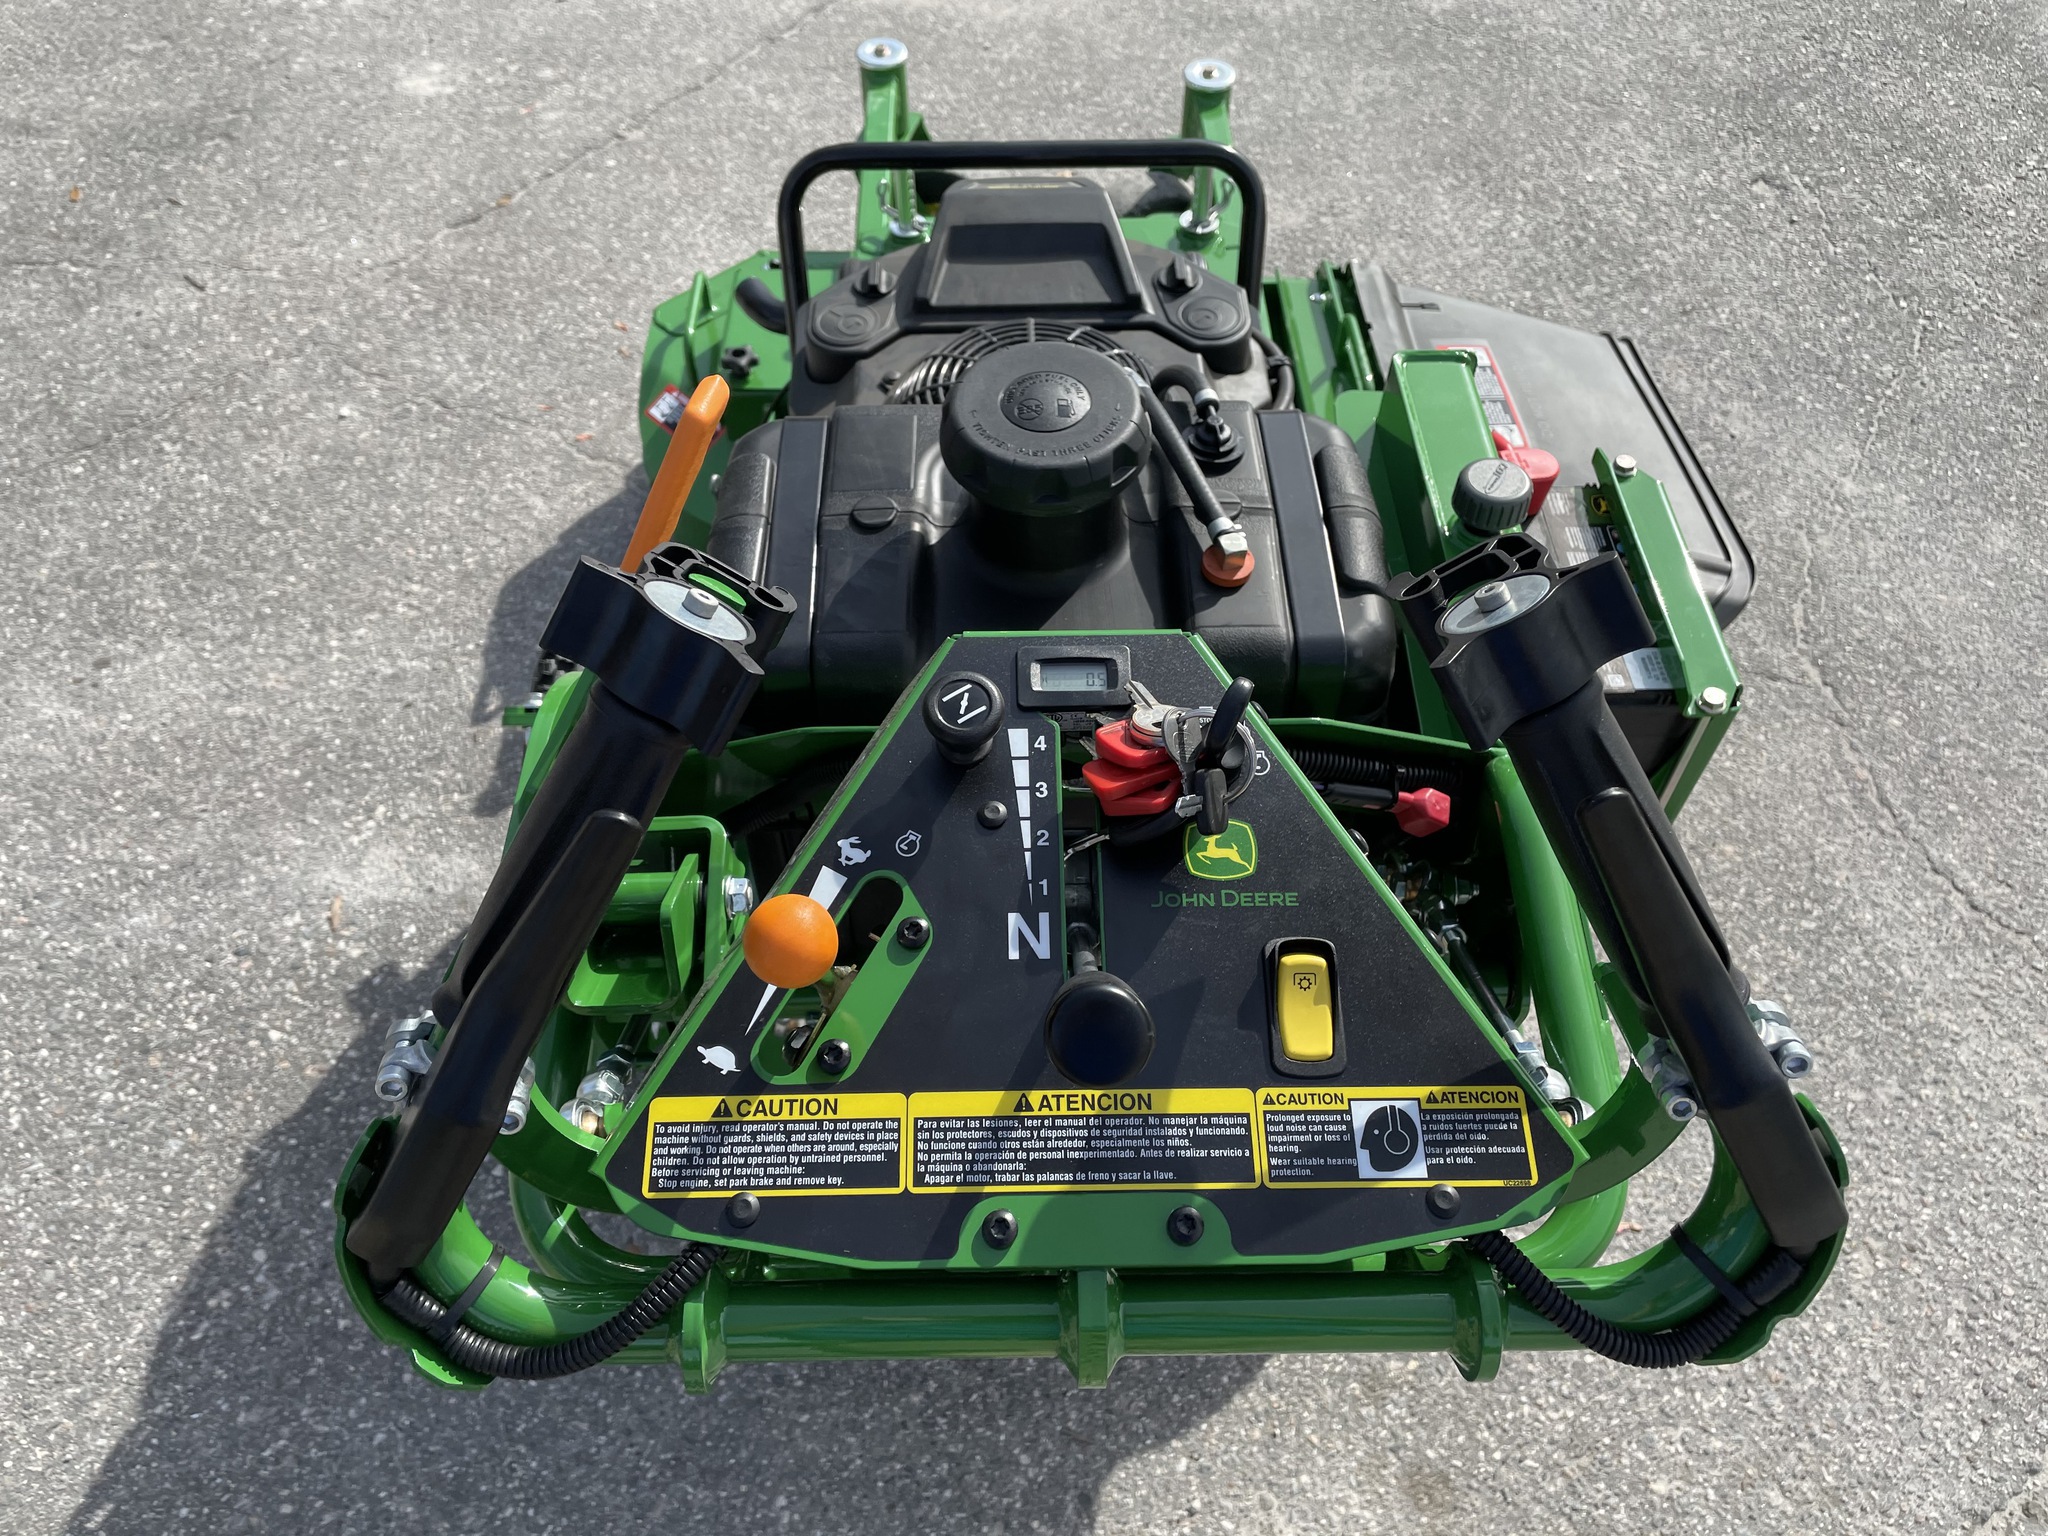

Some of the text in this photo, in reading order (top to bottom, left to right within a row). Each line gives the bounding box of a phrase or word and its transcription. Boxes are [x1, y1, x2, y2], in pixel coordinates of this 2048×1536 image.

[1052, 441, 1090, 456] THREE
[1085, 672, 1106, 687] 0.5
[1034, 735, 1047, 751] 4
[1035, 781, 1048, 798] 3
[1036, 829, 1050, 846] 2
[1038, 878, 1048, 896] 1
[1151, 889, 1300, 908] JOHN DEERE
[1007, 911, 1051, 960] N
[1037, 1093, 1151, 1111] ATENCION
[1276, 1093, 1344, 1106] CAUTION
[1440, 1091, 1518, 1104] ATENCION
[736, 1098, 838, 1117] CAUTION
[917, 1119, 937, 1129] Para
[939, 1119, 964, 1128] evitar
[967, 1119, 979, 1128] las
[982, 1118, 1021, 1129] lesiones,
[1024, 1118, 1041, 1127] leer
[1054, 1117, 1086, 1127] manual
[1088, 1117, 1101, 1127] del
[1104, 1117, 1145, 1128] operador.
[1162, 1116, 1197, 1128] manejar
[1210, 1115, 1247, 1127] máquina
[1265, 1114, 1341, 1123] Prolonged exposure
[667, 1123, 690, 1133] avoid
[692, 1123, 718, 1135] injury,
[721, 1123, 740, 1132] read
[742, 1122, 784, 1134] operator's
[786, 1121, 820, 1131] manual.
[822, 1121, 834, 1131] Do
[836, 1121, 849, 1130] not
[851, 1120, 883, 1132] operate
[885, 1120, 898, 1129] the
[1266, 1124, 1283, 1132] loud
[1285, 1124, 1306, 1132] noise
[1454, 1122, 1482, 1130] fuertes
[654, 1134, 689, 1144] machine
[691, 1133, 721, 1143] without
[723, 1133, 753, 1145] guards,
[755, 1133, 788, 1144] shields,
[790, 1132, 805, 1142] and
[807, 1132, 832, 1144] safety
[833, 1132, 864, 1141] devices
[876, 1131, 898, 1143] place
[917, 1131, 929, 1139] sin
[931, 1130, 944, 1139] los
[946, 1130, 995, 1141] protectores,
[997, 1129, 1031, 1138] escudos
[1039, 1129, 1088, 1140] dispositivos
[1102, 1128, 1142, 1139] seguridad
[1145, 1127, 1187, 1137] instalados
[1195, 1127, 1248, 1136] funcionando.
[1267, 1133, 1312, 1144] impairment
[1324, 1133, 1340, 1142] loss
[1454, 1132, 1466, 1140] del
[653, 1145, 668, 1155] and
[669, 1145, 703, 1157] working.
[718, 1144, 731, 1154] not
[732, 1144, 762, 1156] operate
[763, 1144, 785, 1153] when
[786, 1143, 811, 1153] others
[812, 1145, 825, 1153] are
[827, 1142, 857, 1154] around,
[859, 1142, 898, 1154] especially
[930, 1140, 965, 1150] funcione
[967, 1140, 997, 1149] cuando
[999, 1139, 1020, 1149] otros
[1022, 1139, 1044, 1149] están
[1046, 1139, 1088, 1150] alrededor,
[1090, 1138, 1150, 1150] especialmente
[1152, 1138, 1164, 1147] los
[1166, 1137, 1191, 1147] niños.
[1268, 1144, 1301, 1154] hearing.
[1424, 1145, 1525, 1156] Usar protección adecuada
[652, 1156, 689, 1166] children.
[706, 1155, 719, 1165] not
[721, 1155, 745, 1165] allow
[747, 1154, 786, 1166] operation
[801, 1153, 840, 1163] untrained
[842, 1153, 887, 1165] personnel.
[930, 1151, 962, 1163] permita
[974, 1150, 1014, 1162] operación
[1029, 1150, 1064, 1162] personal
[1066, 1149, 1137, 1161] inexperimentado.
[1139, 1149, 1162, 1158] Antes
[1177, 1148, 1208, 1158] realizar
[1209, 1148, 1242, 1158] servicio
[1269, 1156, 1357, 1167] Wear suitable hearing
[1426, 1158, 1444, 1166] para
[651, 1167, 678, 1177] Before
[681, 1166, 720, 1178] servicing
[733, 1165, 764, 1177] leaving
[766, 1164, 805, 1174] machine:
[927, 1162, 962, 1173] máquina
[972, 1161, 1026, 1171] abandonarla:
[1270, 1167, 1313, 1178] protection.
[658, 1175, 844, 1190] Stop engine, set park brake and remove key.
[923, 1173, 953, 1185] Apagar
[966, 1173, 992, 1184] motor,
[994, 1172, 1020, 1182] trabar
[1021, 1172, 1034, 1182] las
[1036, 1172, 1073, 1184] palancas
[1087, 1171, 1109, 1181] freno
[1118, 1173, 1140, 1181] sacar
[1153, 1170, 1176, 1180] llave.
